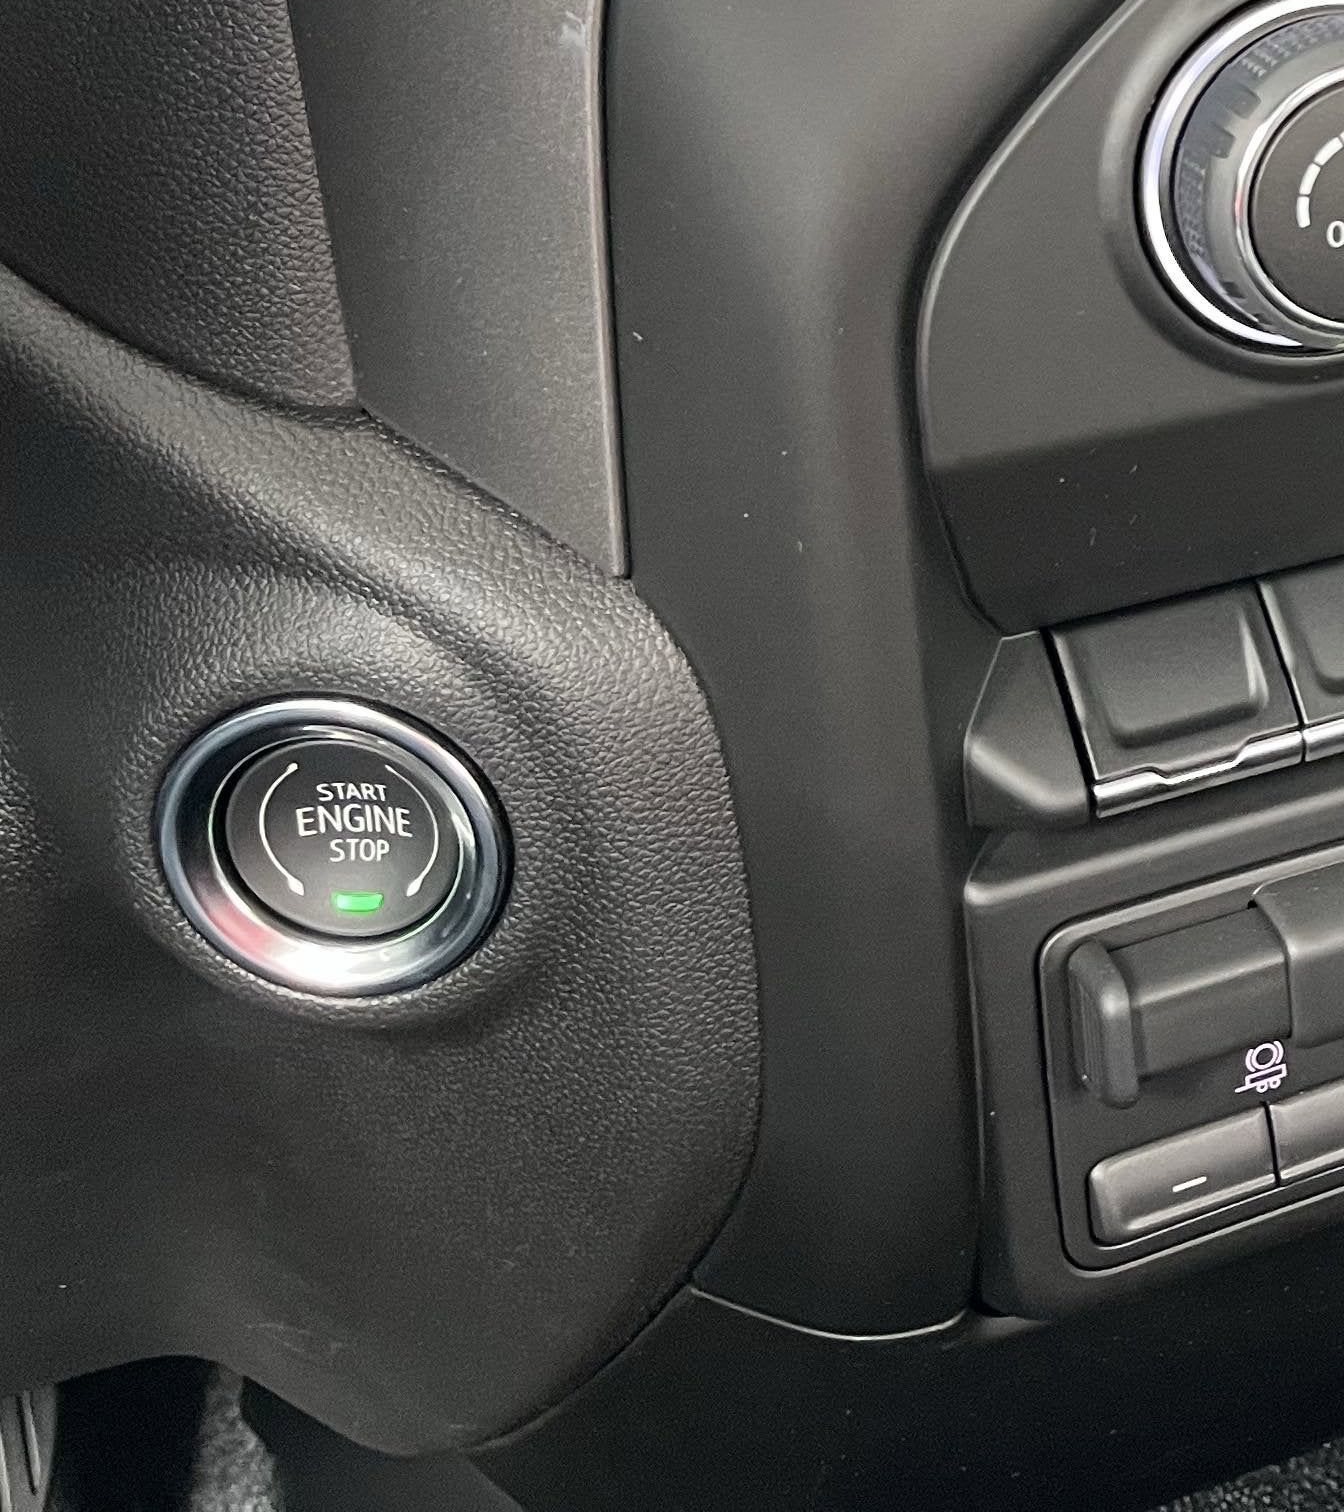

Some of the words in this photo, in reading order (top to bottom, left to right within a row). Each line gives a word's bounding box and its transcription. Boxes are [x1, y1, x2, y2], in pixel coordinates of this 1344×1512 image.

[316, 783, 387, 802] START
[295, 803, 413, 838] ENGINE
[329, 838, 390, 863] STOP
